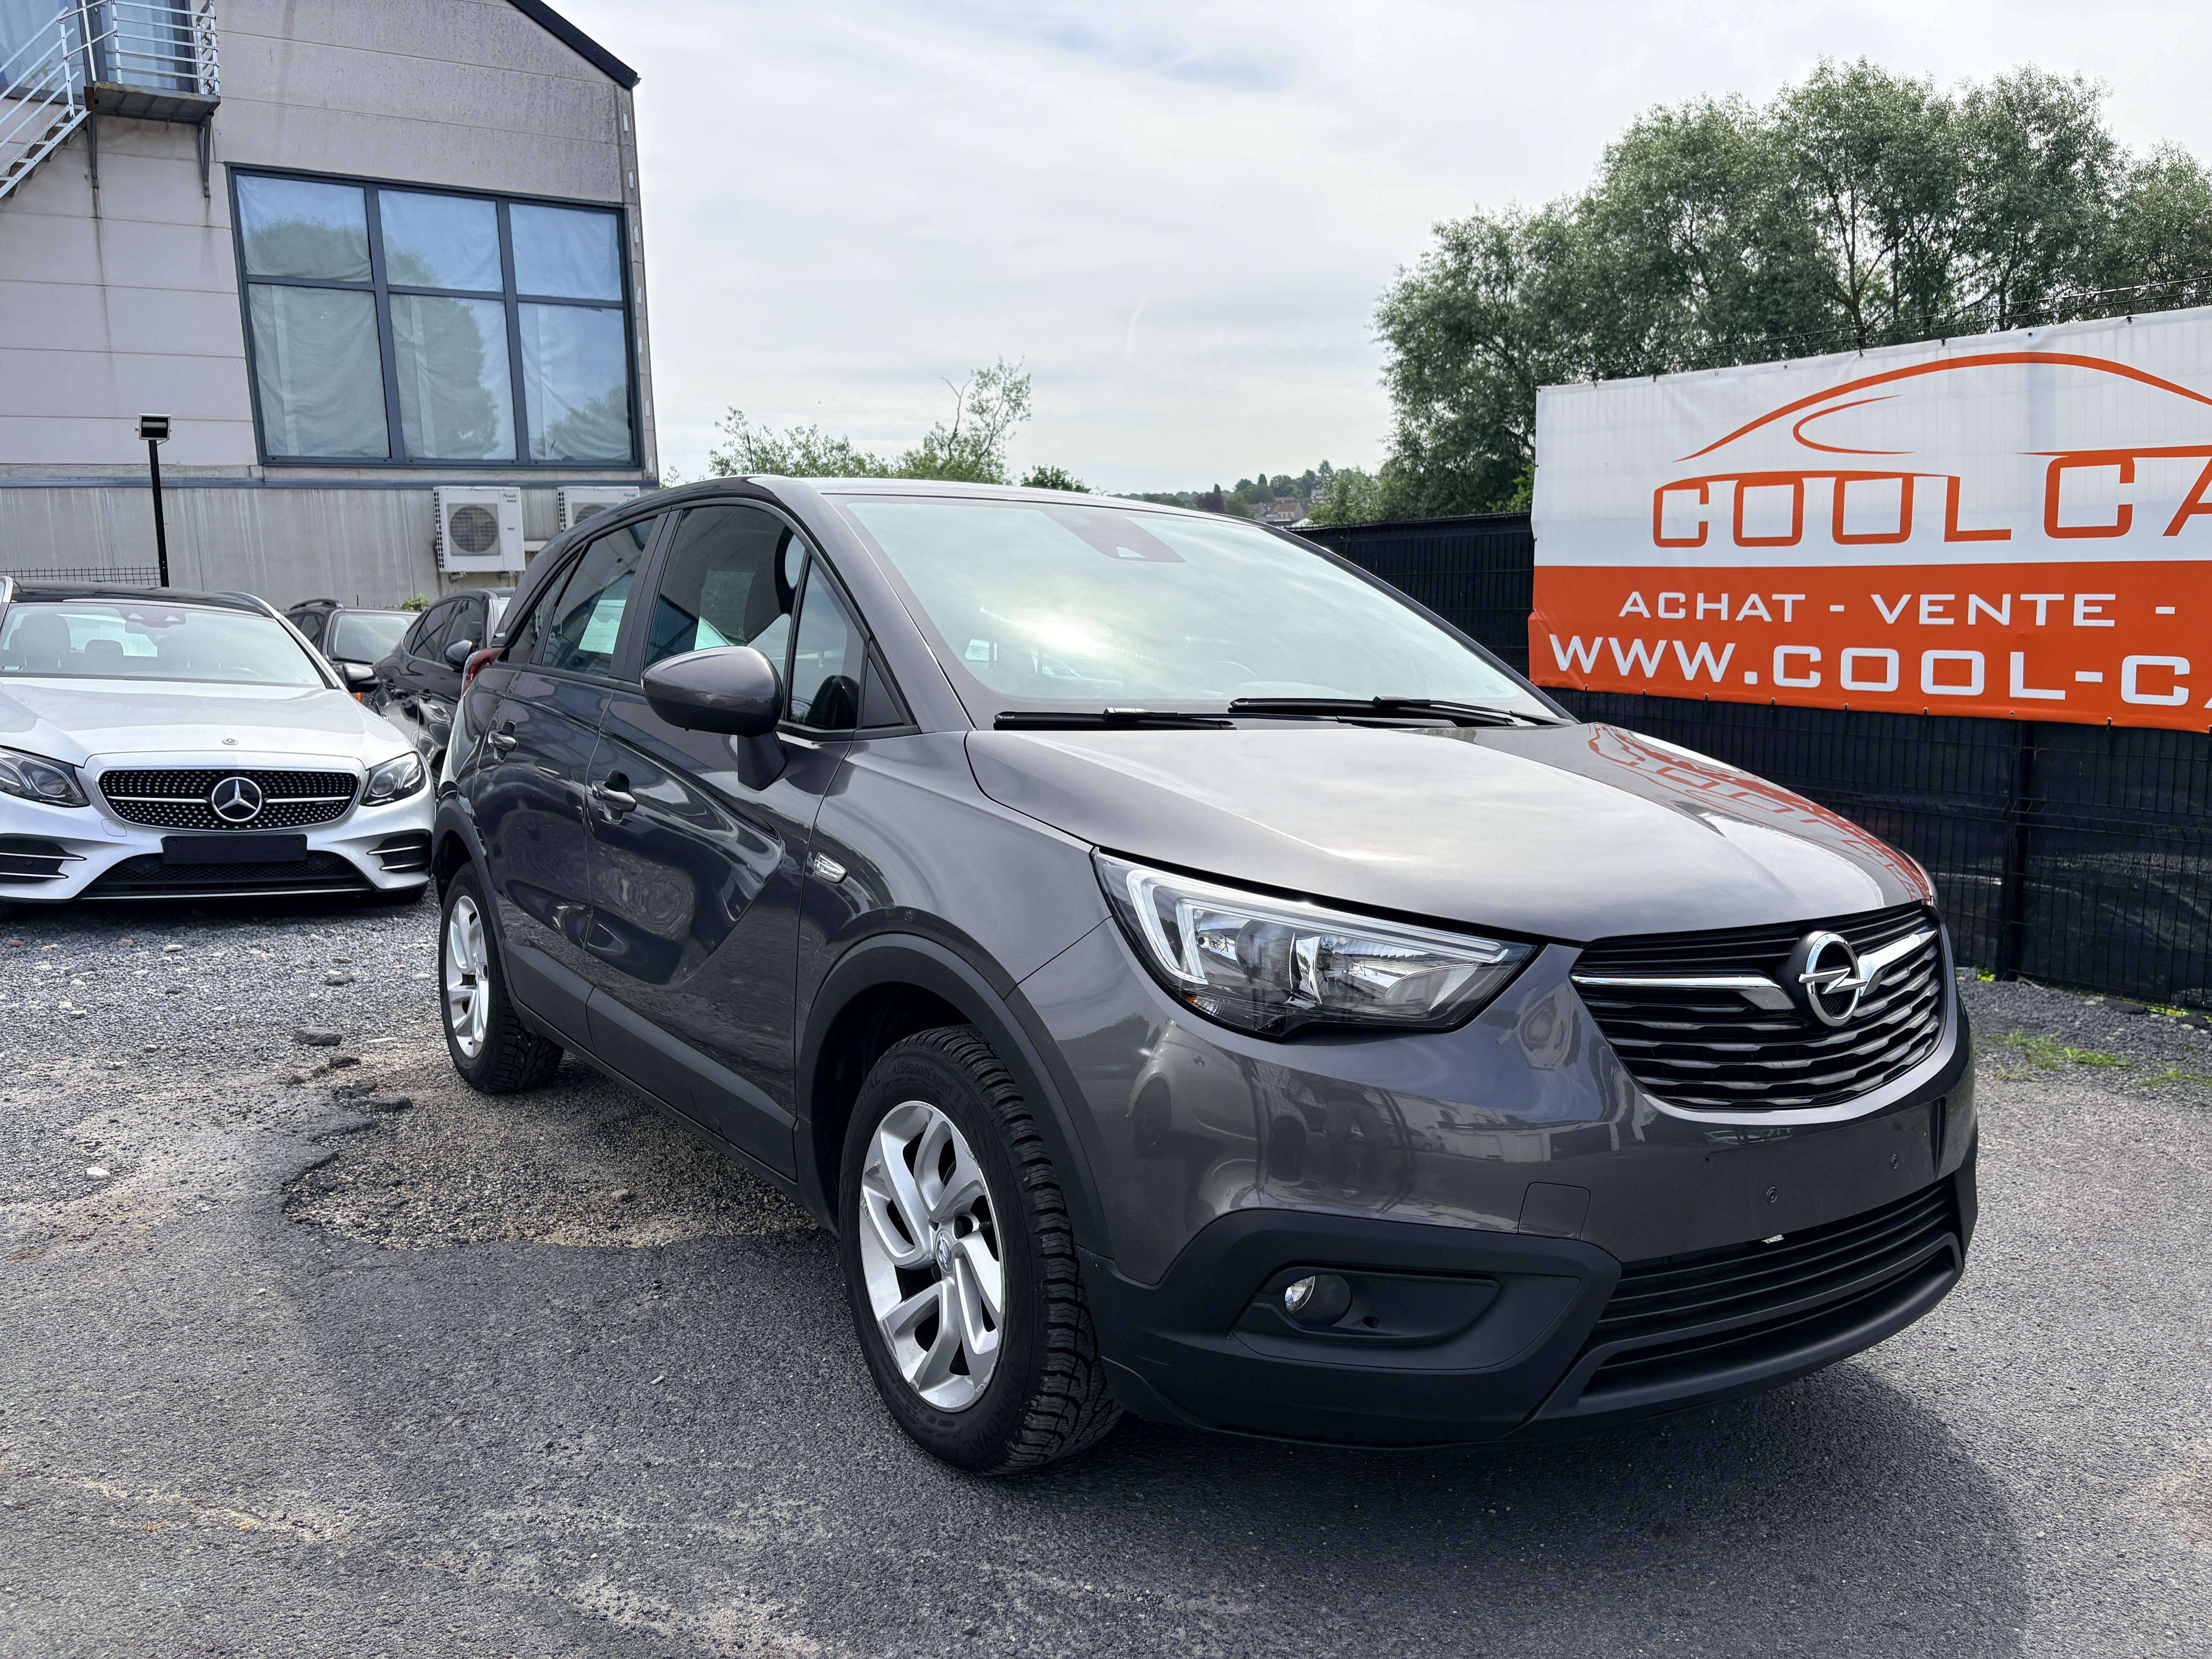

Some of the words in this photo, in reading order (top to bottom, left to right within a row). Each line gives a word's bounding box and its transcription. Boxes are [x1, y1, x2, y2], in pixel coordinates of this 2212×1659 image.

[1654, 471, 2011, 548] COOL
[1619, 591, 1806, 623] ACHAT
[1871, 593, 2116, 627] VENTE
[1549, 633, 2212, 709] WWW.COOL-C
[892, 1061, 954, 1097] AllSeasonExpert
